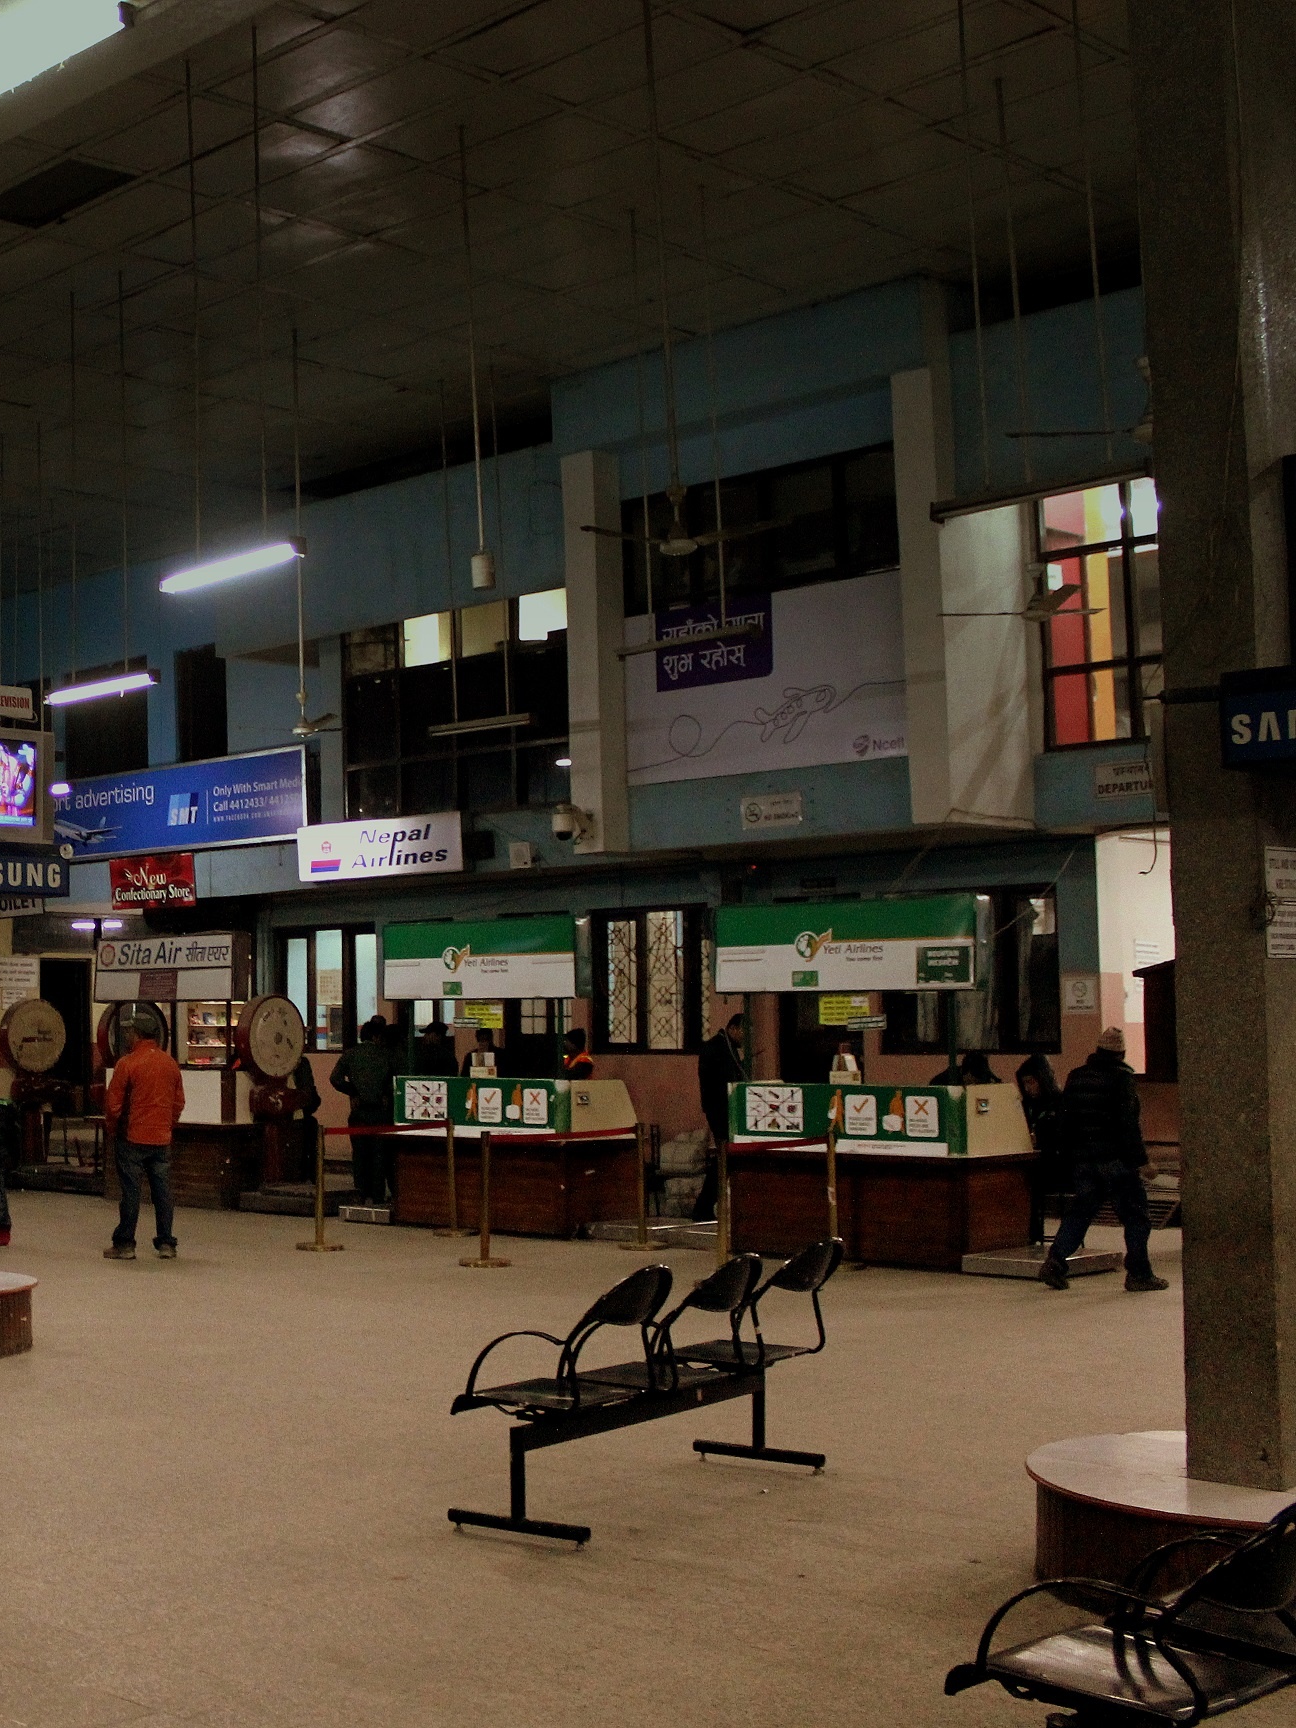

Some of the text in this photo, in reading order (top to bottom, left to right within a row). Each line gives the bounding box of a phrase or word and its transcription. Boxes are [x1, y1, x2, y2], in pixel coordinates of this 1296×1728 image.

[663, 653, 694, 681] शुभ
[75, 782, 155, 810] advertising
[212, 785, 233, 798] Only
[232, 783, 252, 795] With
[253, 780, 278, 792] Smart
[213, 800, 229, 812] Call
[359, 823, 431, 857] Nepal
[352, 849, 447, 868] Airlines
[128, 863, 167, 886] New
[115, 883, 191, 904] Confectionary Store
[118, 941, 182, 966] Sita Air
[823, 943, 884, 954] Yeti Airlines
